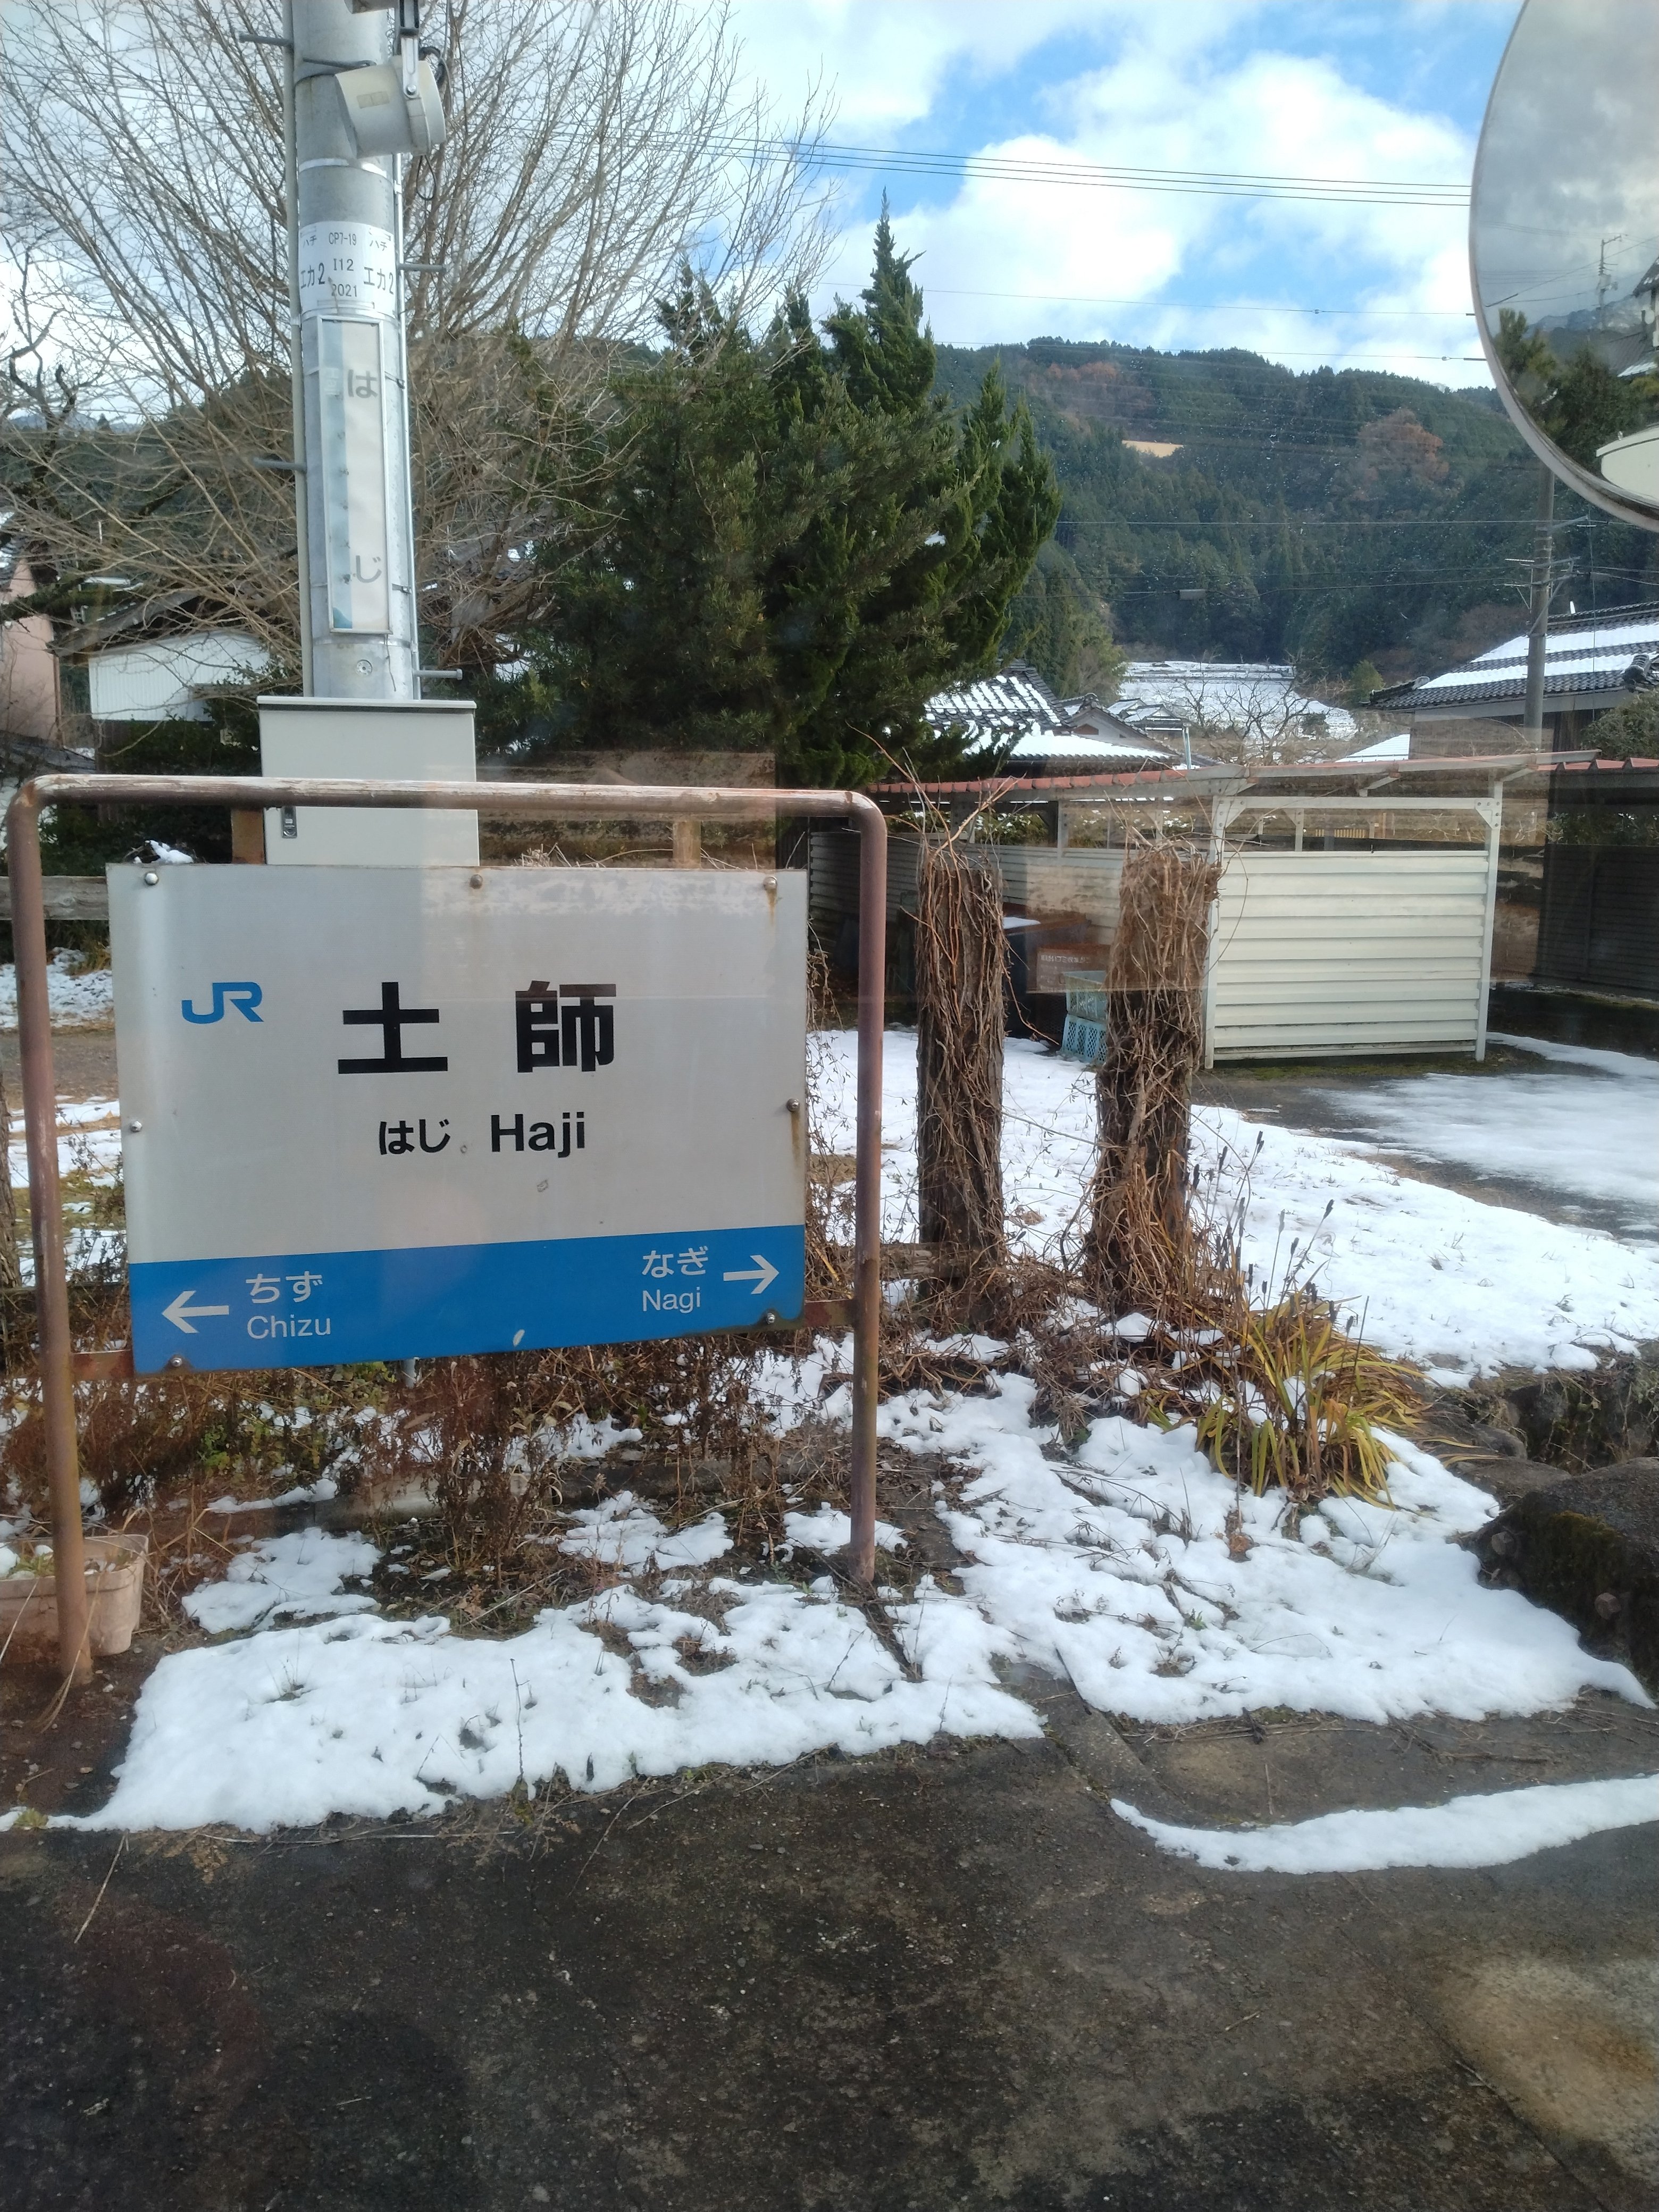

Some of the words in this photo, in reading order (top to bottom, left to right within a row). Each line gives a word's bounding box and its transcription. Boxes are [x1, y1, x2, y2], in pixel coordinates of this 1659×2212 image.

[329, 232, 357, 246] CP7-19
[369, 240, 388, 252] ハチ
[331, 284, 357, 297] 2021
[181, 982, 263, 1025] JR
[337, 981, 615, 1075] 土師
[379, 1118, 451, 1156] はじ
[490, 1111, 585, 1159] Haji
[641, 1245, 709, 1278] なぎ
[245, 1270, 323, 1304] ちず
[642, 1287, 701, 1313] Nagi
[247, 1314, 331, 1339] Chizu
